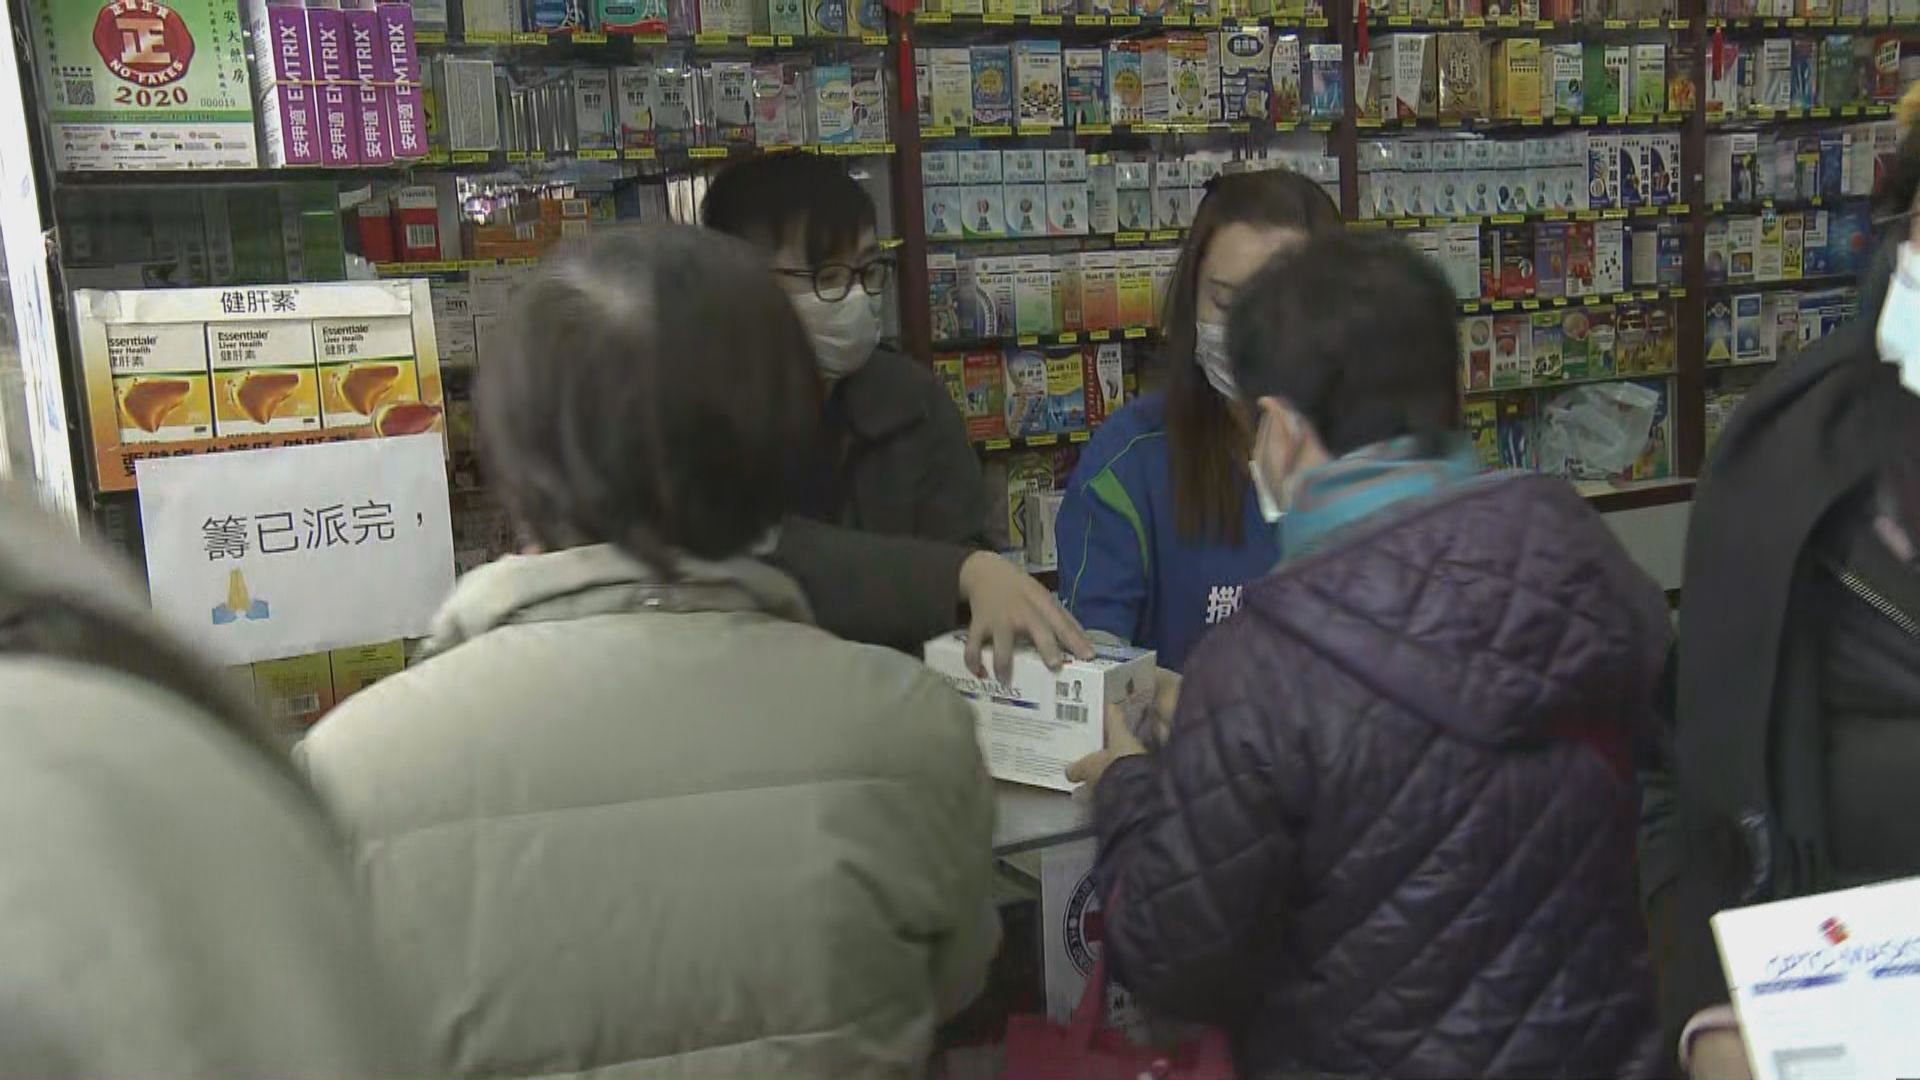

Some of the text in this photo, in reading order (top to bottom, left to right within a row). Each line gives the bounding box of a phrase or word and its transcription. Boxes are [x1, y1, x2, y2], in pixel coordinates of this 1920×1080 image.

[280, 26, 304, 101] EMTRIX
[319, 28, 343, 103] EMTRIX
[352, 29, 377, 103] EMTRIX
[388, 23, 411, 95] EMTRIX
[110, 59, 131, 78] NO
[138, 59, 184, 86] FAKES
[114, 86, 189, 108] 2020
[220, 289, 298, 314] 健肝素
[108, 335, 156, 347] ssentiale
[217, 330, 268, 343] Essentiale
[322, 324, 370, 337] Essentiale
[219, 340, 263, 350] Liver Health
